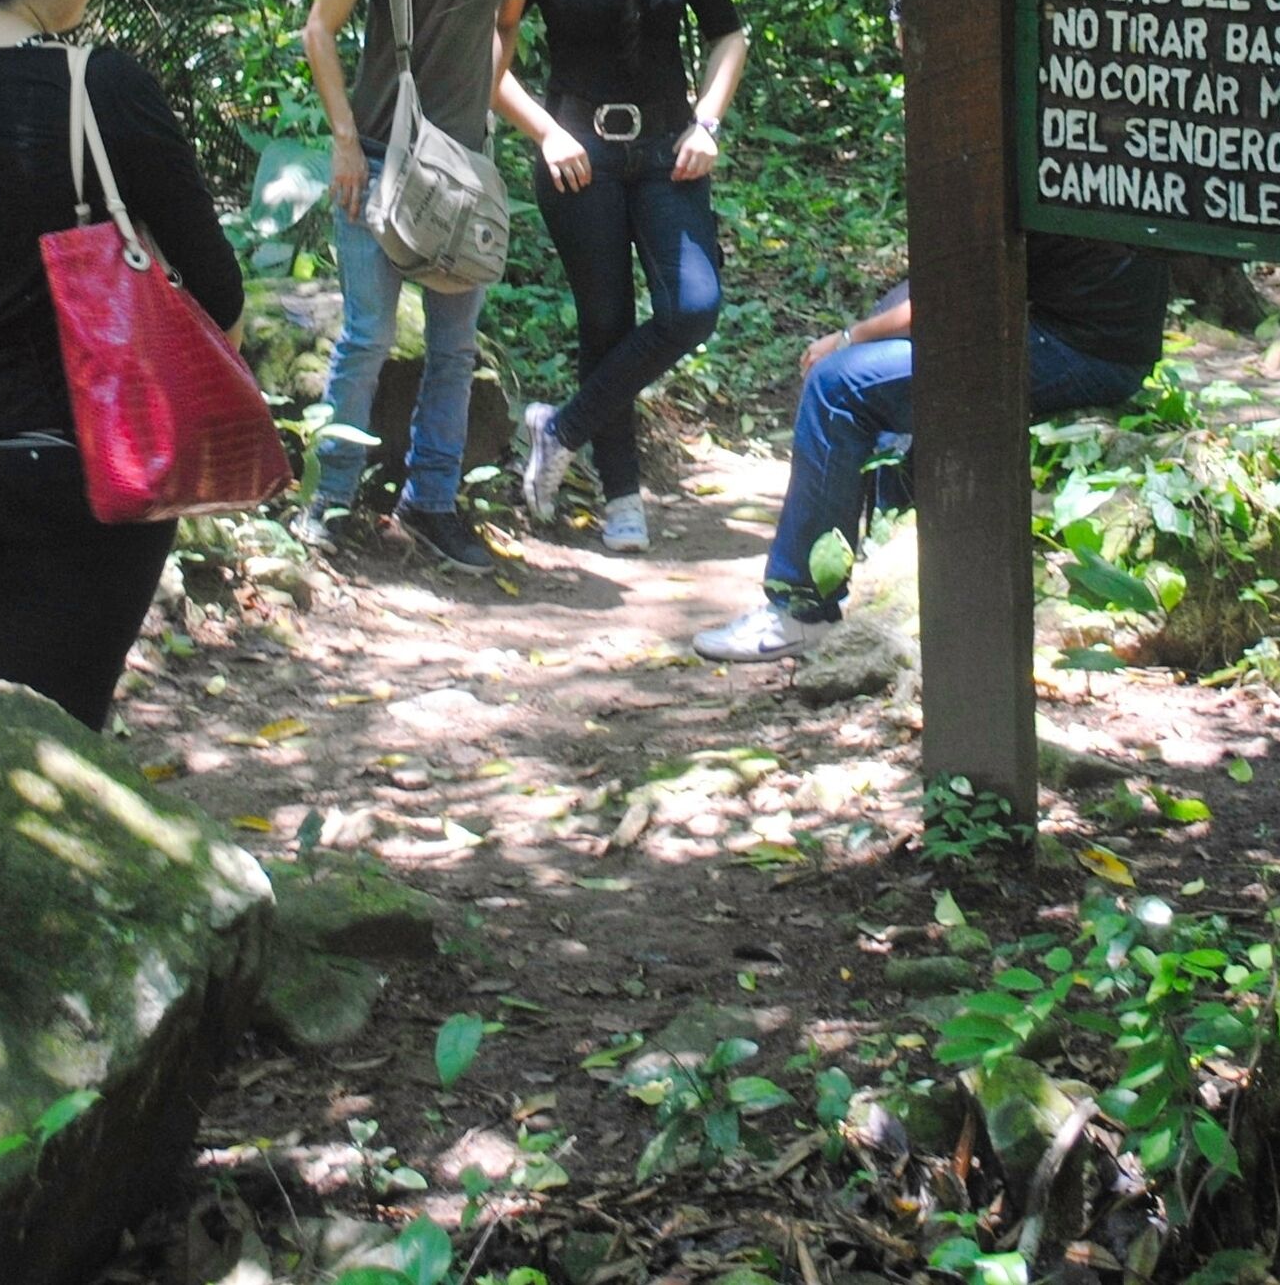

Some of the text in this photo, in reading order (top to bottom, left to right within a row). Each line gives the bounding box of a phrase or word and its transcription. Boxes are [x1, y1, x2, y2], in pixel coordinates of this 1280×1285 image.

[1052, 6, 1099, 50] NO
[1105, 9, 1208, 60] TIRAR
[1049, 53, 1096, 100] NO
[1100, 61, 1240, 116] CORTAR
[1042, 106, 1109, 153] DEL
[1037, 156, 1189, 215] CAMINAR
